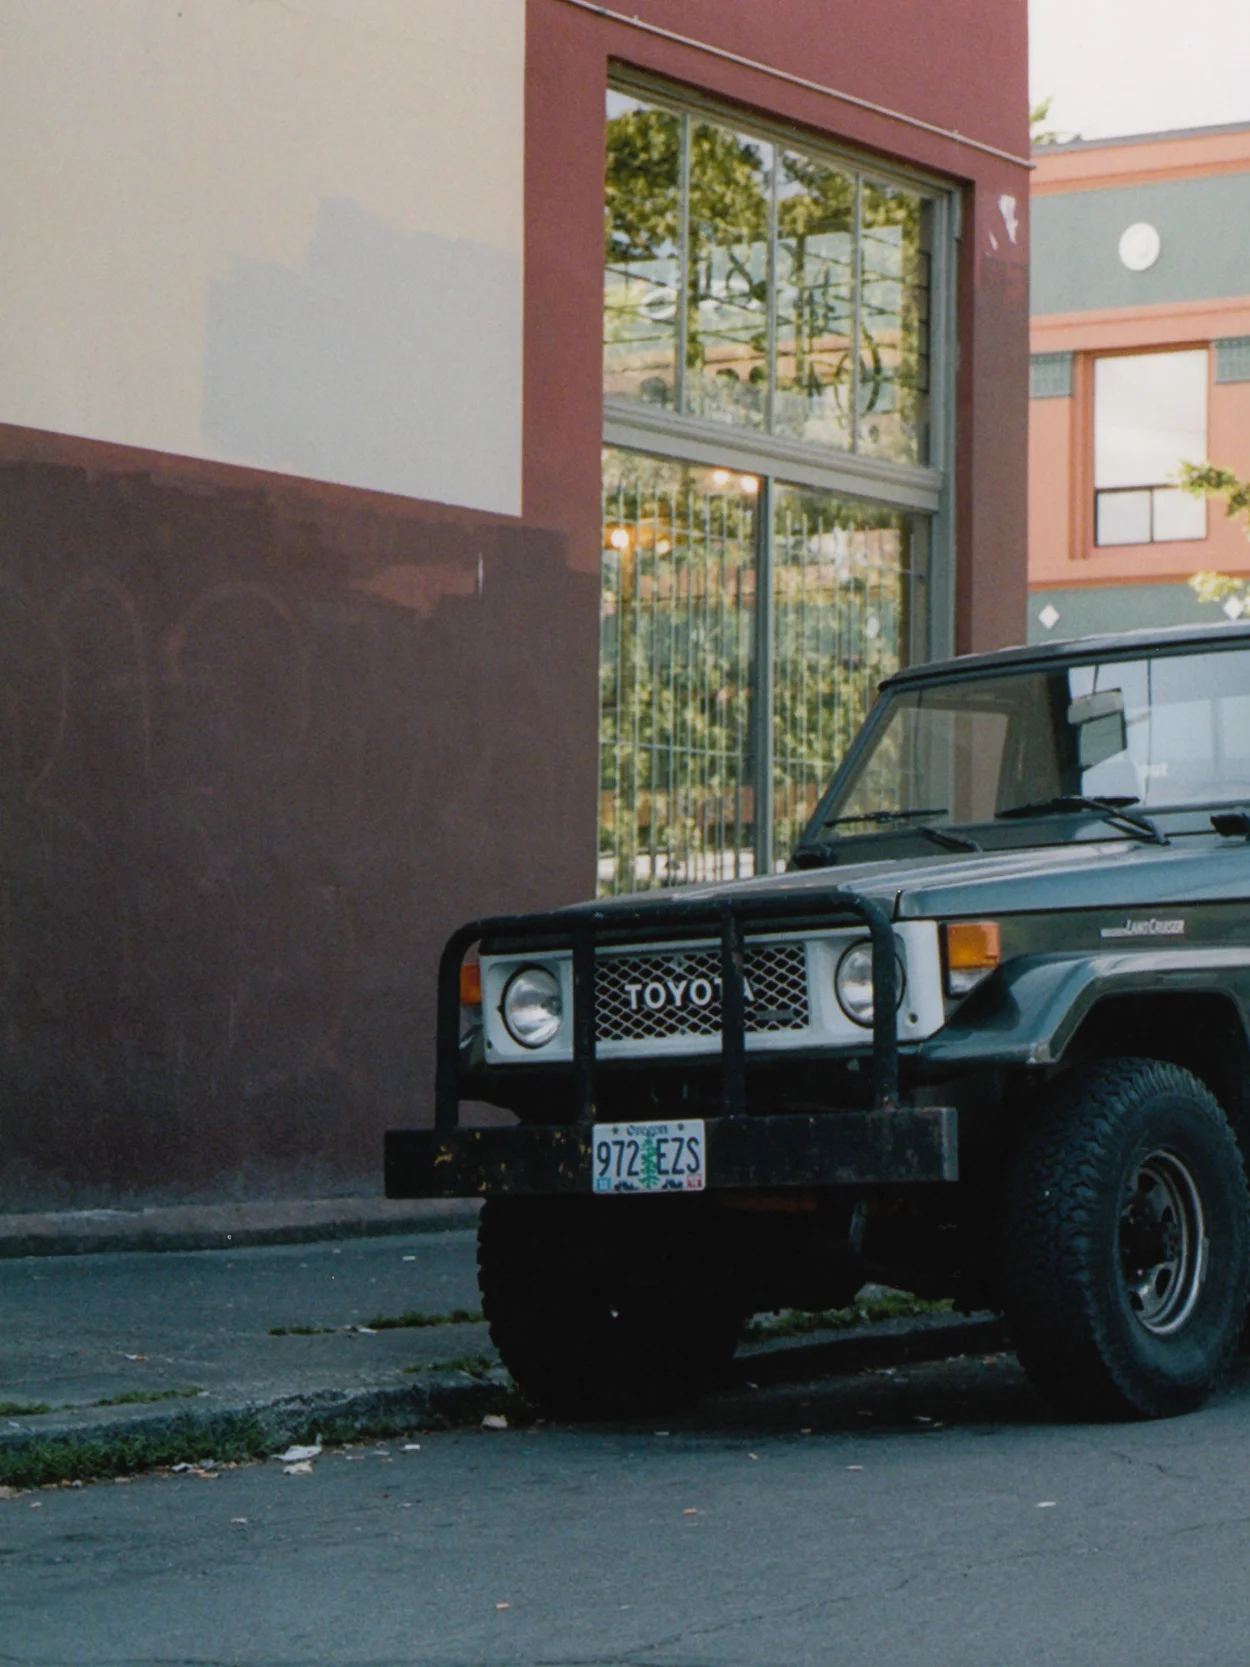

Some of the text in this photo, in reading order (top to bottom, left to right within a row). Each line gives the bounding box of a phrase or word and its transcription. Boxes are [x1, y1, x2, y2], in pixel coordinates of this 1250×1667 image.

[626, 1125, 668, 1137] Oregon
[597, 1136, 700, 1177] 972 EZS
